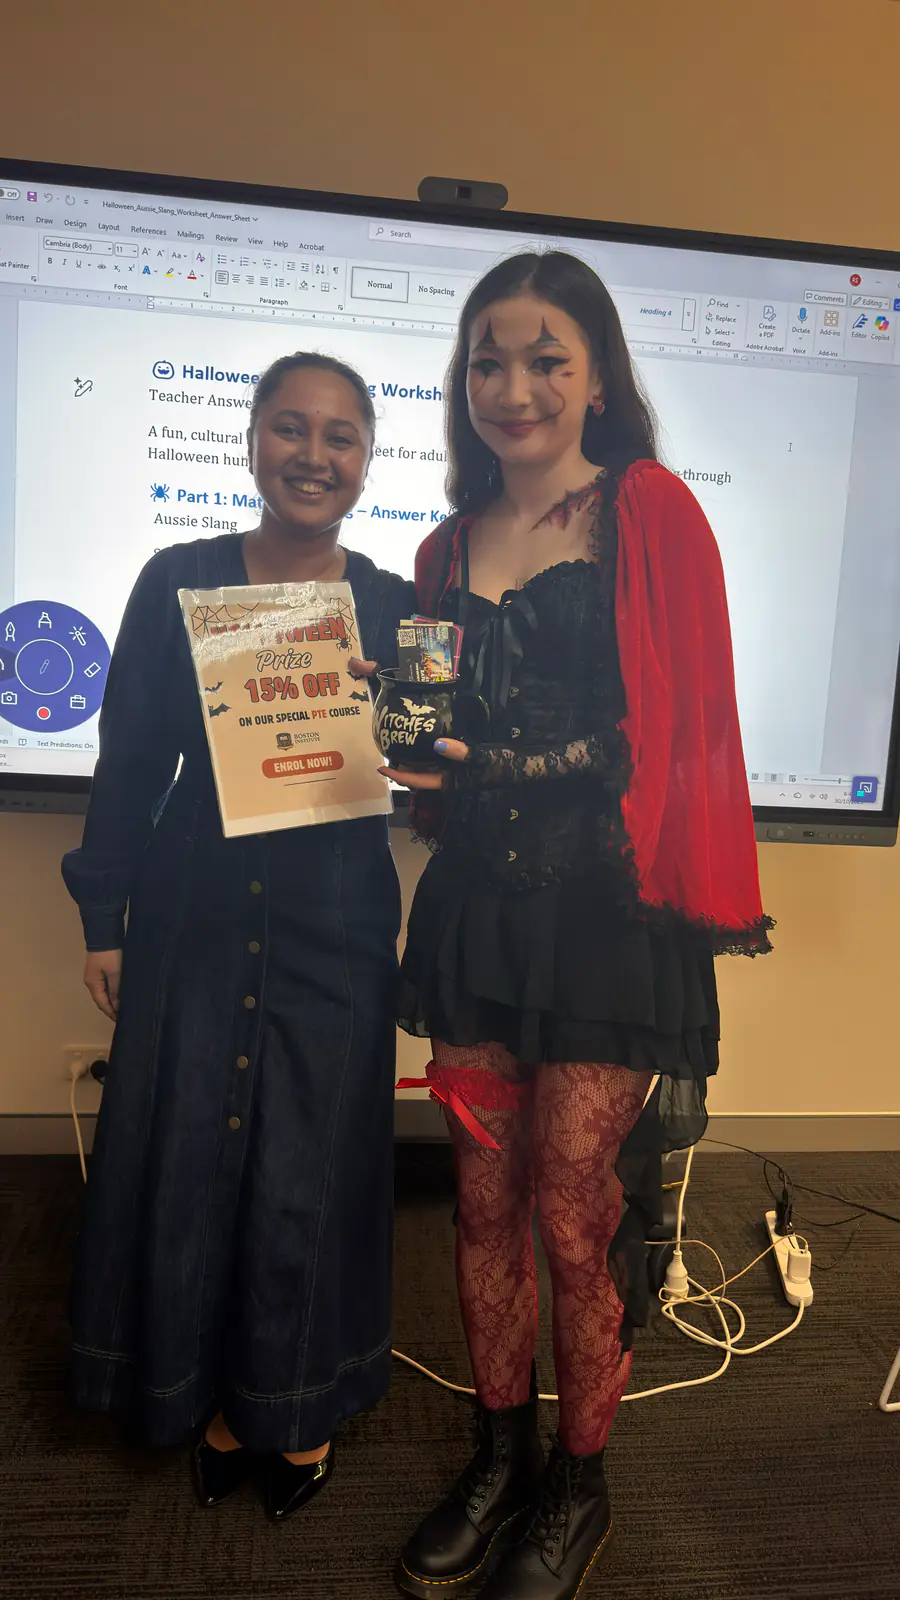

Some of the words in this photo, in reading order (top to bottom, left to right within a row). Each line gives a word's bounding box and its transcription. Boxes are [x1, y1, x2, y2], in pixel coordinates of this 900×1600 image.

[102, 201, 250, 222] Halloween_Aussie_Slang_Worksheet_Answer_Sheet
[6, 214, 25, 222] Insert
[36, 217, 54, 225] Draw
[64, 220, 87, 229] Design
[98, 223, 120, 231] Layout
[131, 226, 167, 236] References
[177, 231, 204, 240] Mailings
[216, 235, 238, 243] Review
[248, 237, 263, 245] View
[273, 240, 288, 249] Help
[299, 242, 324, 251] Acrobat
[390, 230, 411, 238] Search
[45, 239, 71, 248] Cambria
[72, 242, 92, 251] (Body)
[8, 261, 30, 270] Painter
[367, 280, 393, 290] Normal
[418, 285, 428, 293] No
[429, 286, 455, 297] Spacing
[259, 297, 289, 306] Paragraph
[814, 294, 844, 304] Comments
[862, 299, 882, 308] Editing
[640, 307, 666, 317] Heading
[715, 314, 736, 323] Replace
[758, 322, 776, 331] Create
[792, 326, 810, 335] Dictate
[714, 328, 730, 336] Select
[820, 328, 840, 336] Add-ins
[851, 331, 867, 339] Editor
[870, 333, 890, 342] Copilot
[712, 340, 731, 348] Editing
[746, 343, 763, 351] Adobe
[182, 365, 260, 384] Hallowee
[381, 382, 442, 401] Worksh
[149, 388, 204, 405] Teacher
[207, 394, 252, 410] Answe
[148, 425, 158, 437] A
[161, 426, 187, 442] fun,
[190, 429, 243, 445] cultural
[398, 446, 417, 460] for
[420, 449, 448, 462] adul
[148, 447, 219, 464] Halloween
[177, 488, 209, 504] Part
[214, 492, 227, 506] 1:
[232, 493, 263, 509] Mat
[370, 505, 427, 522] Answer
[430, 510, 447, 523] Ke
[153, 512, 198, 527] Aussie
[201, 516, 238, 533] Slang
[256, 648, 313, 672] Prize
[244, 676, 299, 703] 15%
[302, 672, 341, 698] OFF
[239, 716, 253, 727] ON
[255, 715, 274, 726] OUR
[275, 711, 310, 723] SPECIAL
[311, 709, 327, 720] PTE
[329, 706, 361, 718] COURSE
[294, 731, 320, 740] BOSTON
[380, 728, 419, 751] BREW
[50, 741, 83, 749] Predictions:
[273, 757, 305, 773] ENROL
[307, 755, 333, 770] NOW!
